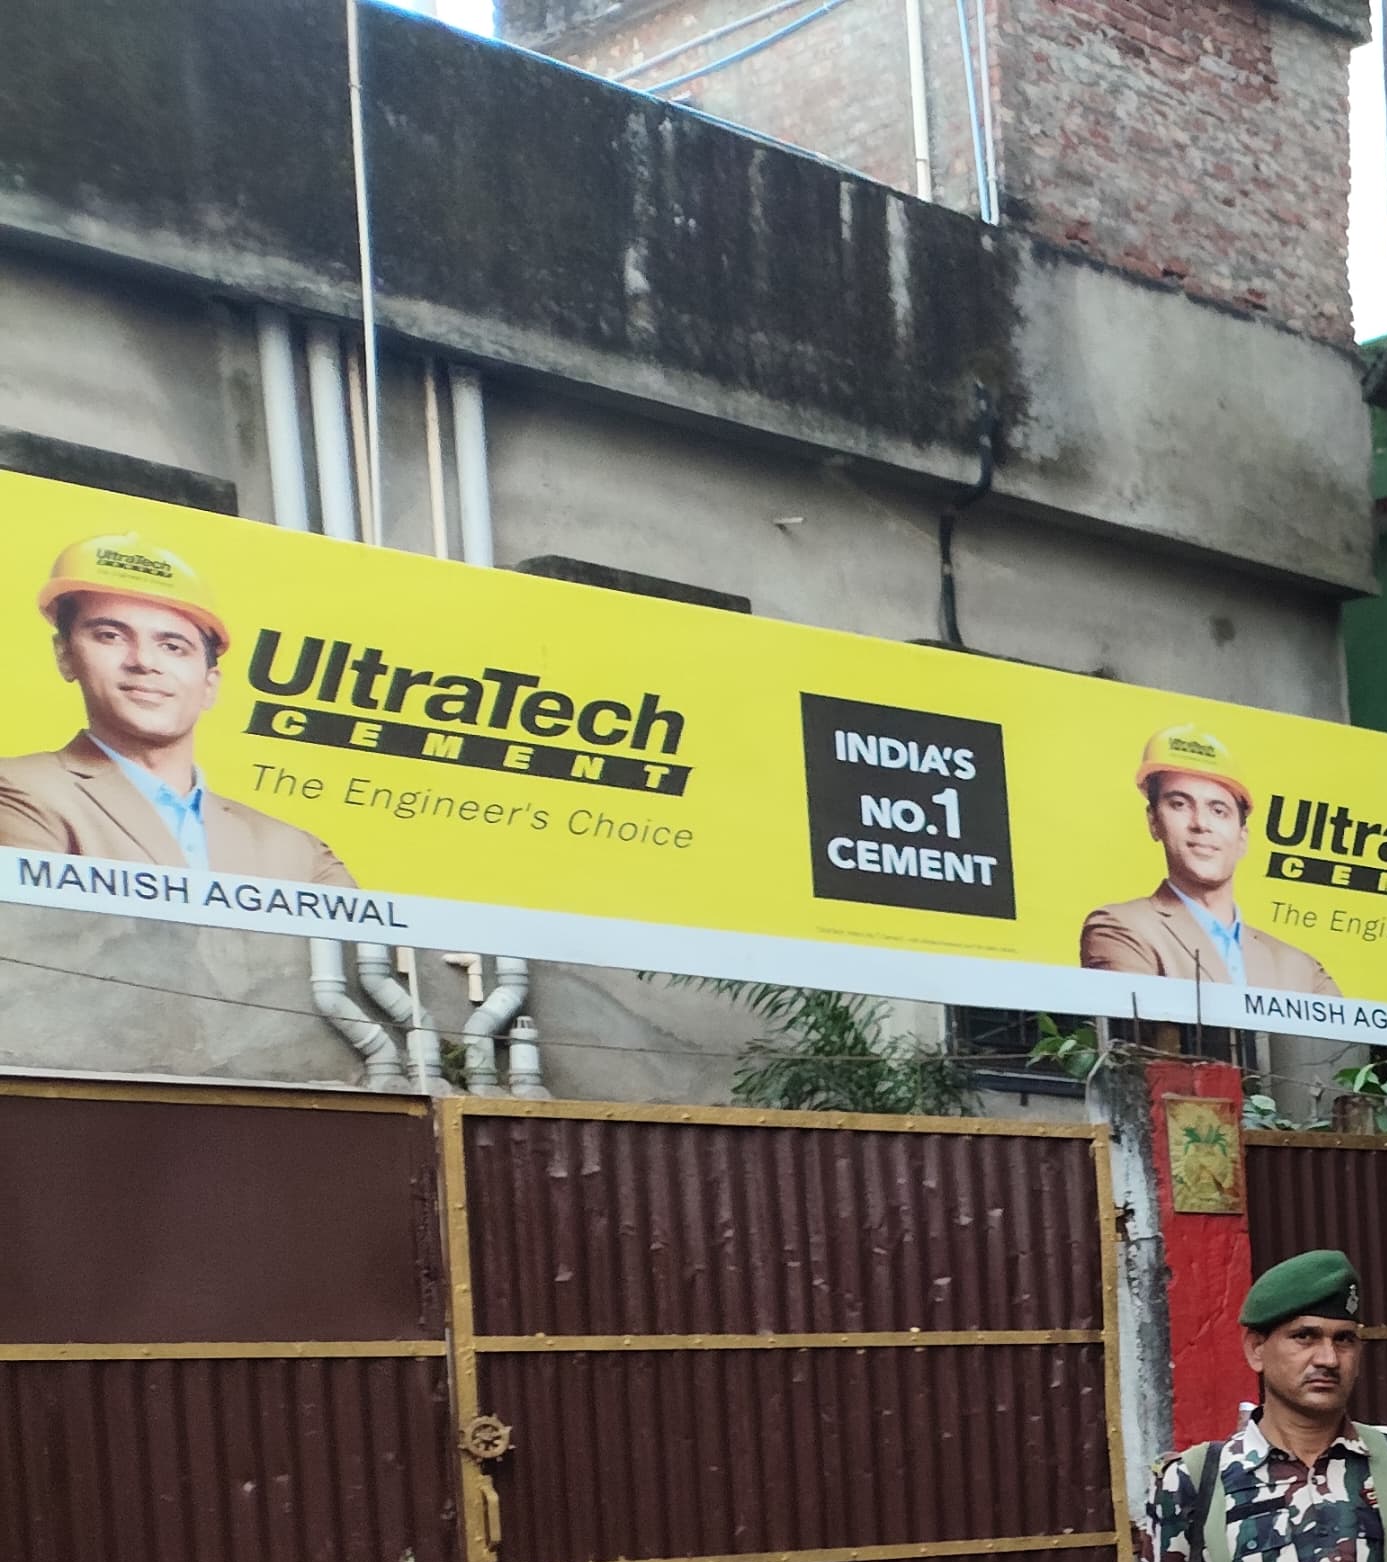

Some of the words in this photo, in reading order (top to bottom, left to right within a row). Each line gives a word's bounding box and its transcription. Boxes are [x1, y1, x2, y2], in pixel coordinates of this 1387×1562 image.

[247, 627, 686, 755] UltraTech
[270, 708, 670, 790] CEMENT
[834, 729, 977, 781] INDIA'S
[251, 763, 324, 800] The
[344, 776, 549, 831] Engineer's
[566, 808, 695, 850] Choice
[860, 787, 961, 840] NO.1
[826, 836, 999, 887] CEMENT
[17, 857, 190, 905] MANISH
[203, 880, 410, 930] AGARWAL
[1271, 900, 1318, 929] The
[1243, 993, 1346, 1026] MANISH
